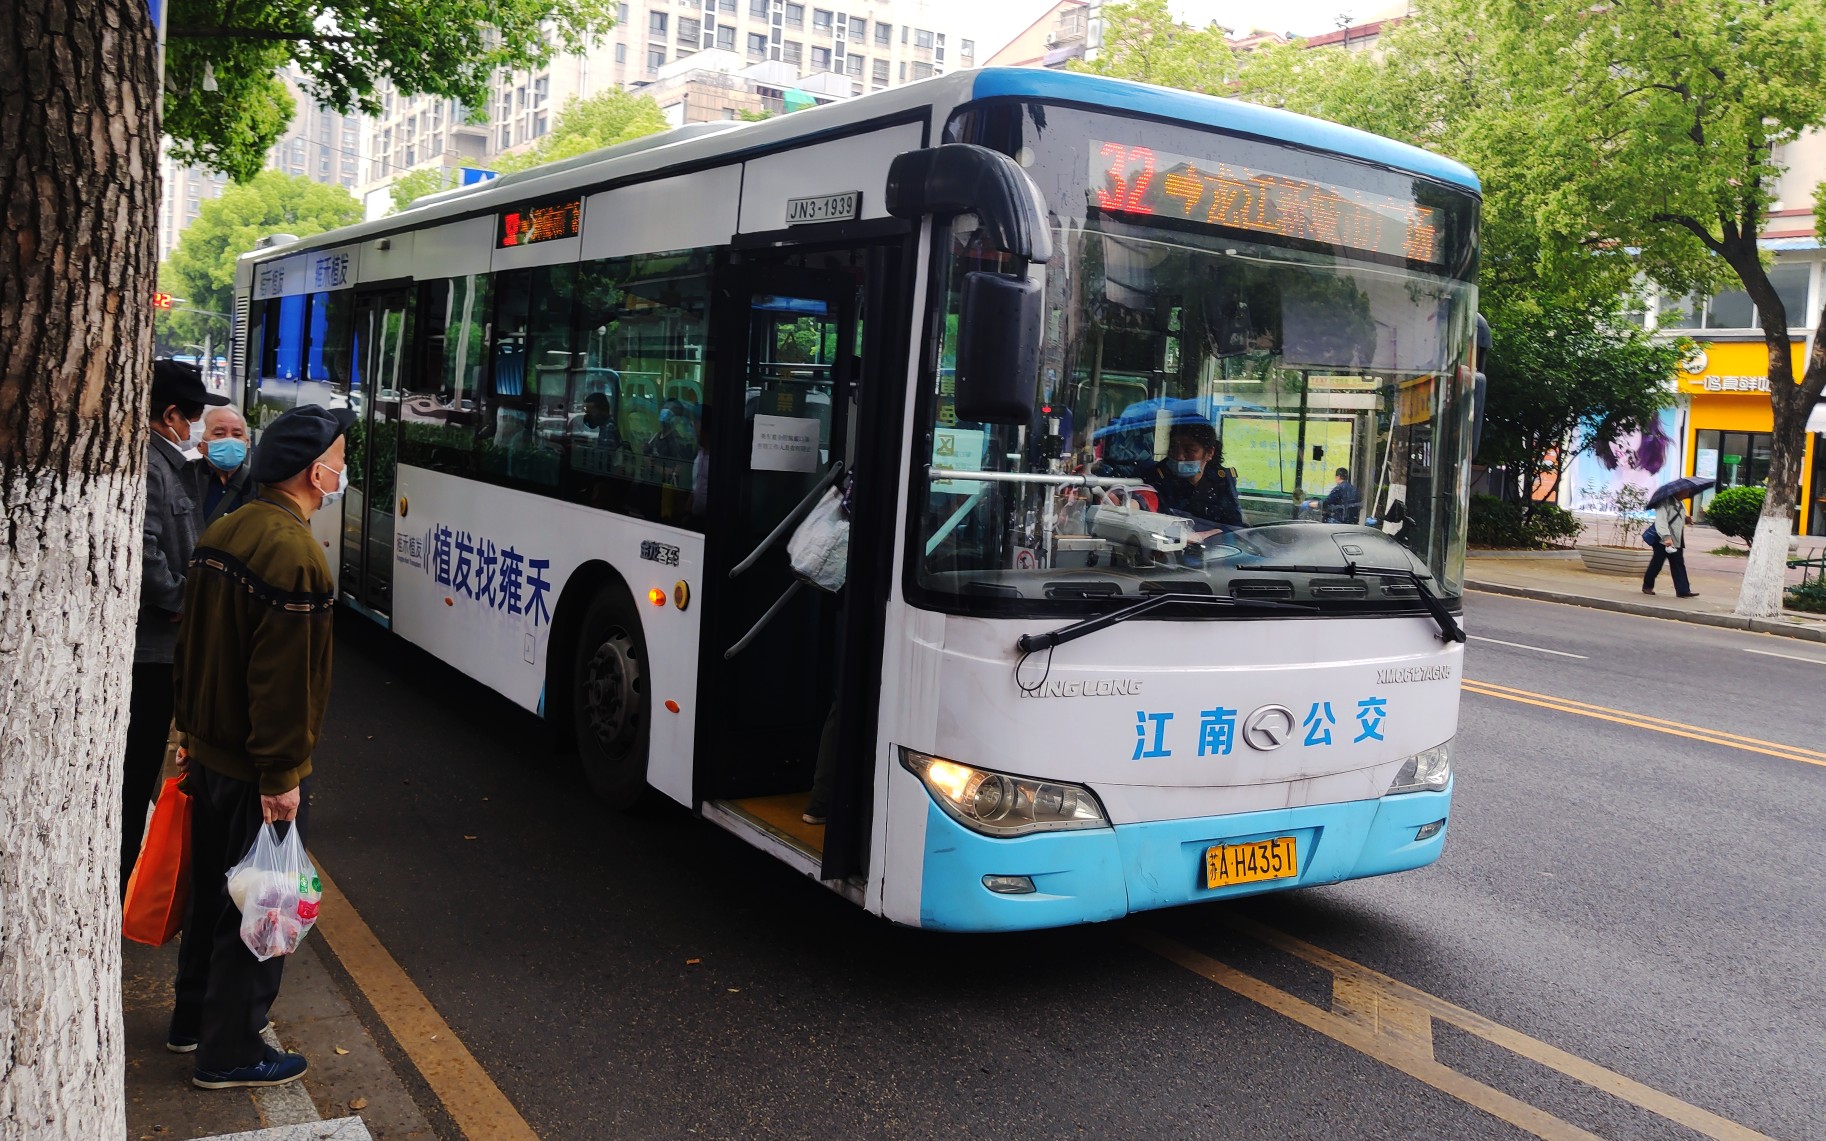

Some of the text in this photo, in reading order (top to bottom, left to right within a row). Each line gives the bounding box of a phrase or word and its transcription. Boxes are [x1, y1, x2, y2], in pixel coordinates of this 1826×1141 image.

[1098, 141, 1155, 214] 32
[790, 196, 853, 220] JN3-1939
[433, 522, 551, 627] 植发找雍禾
[1020, 679, 1143, 699] KING LONG
